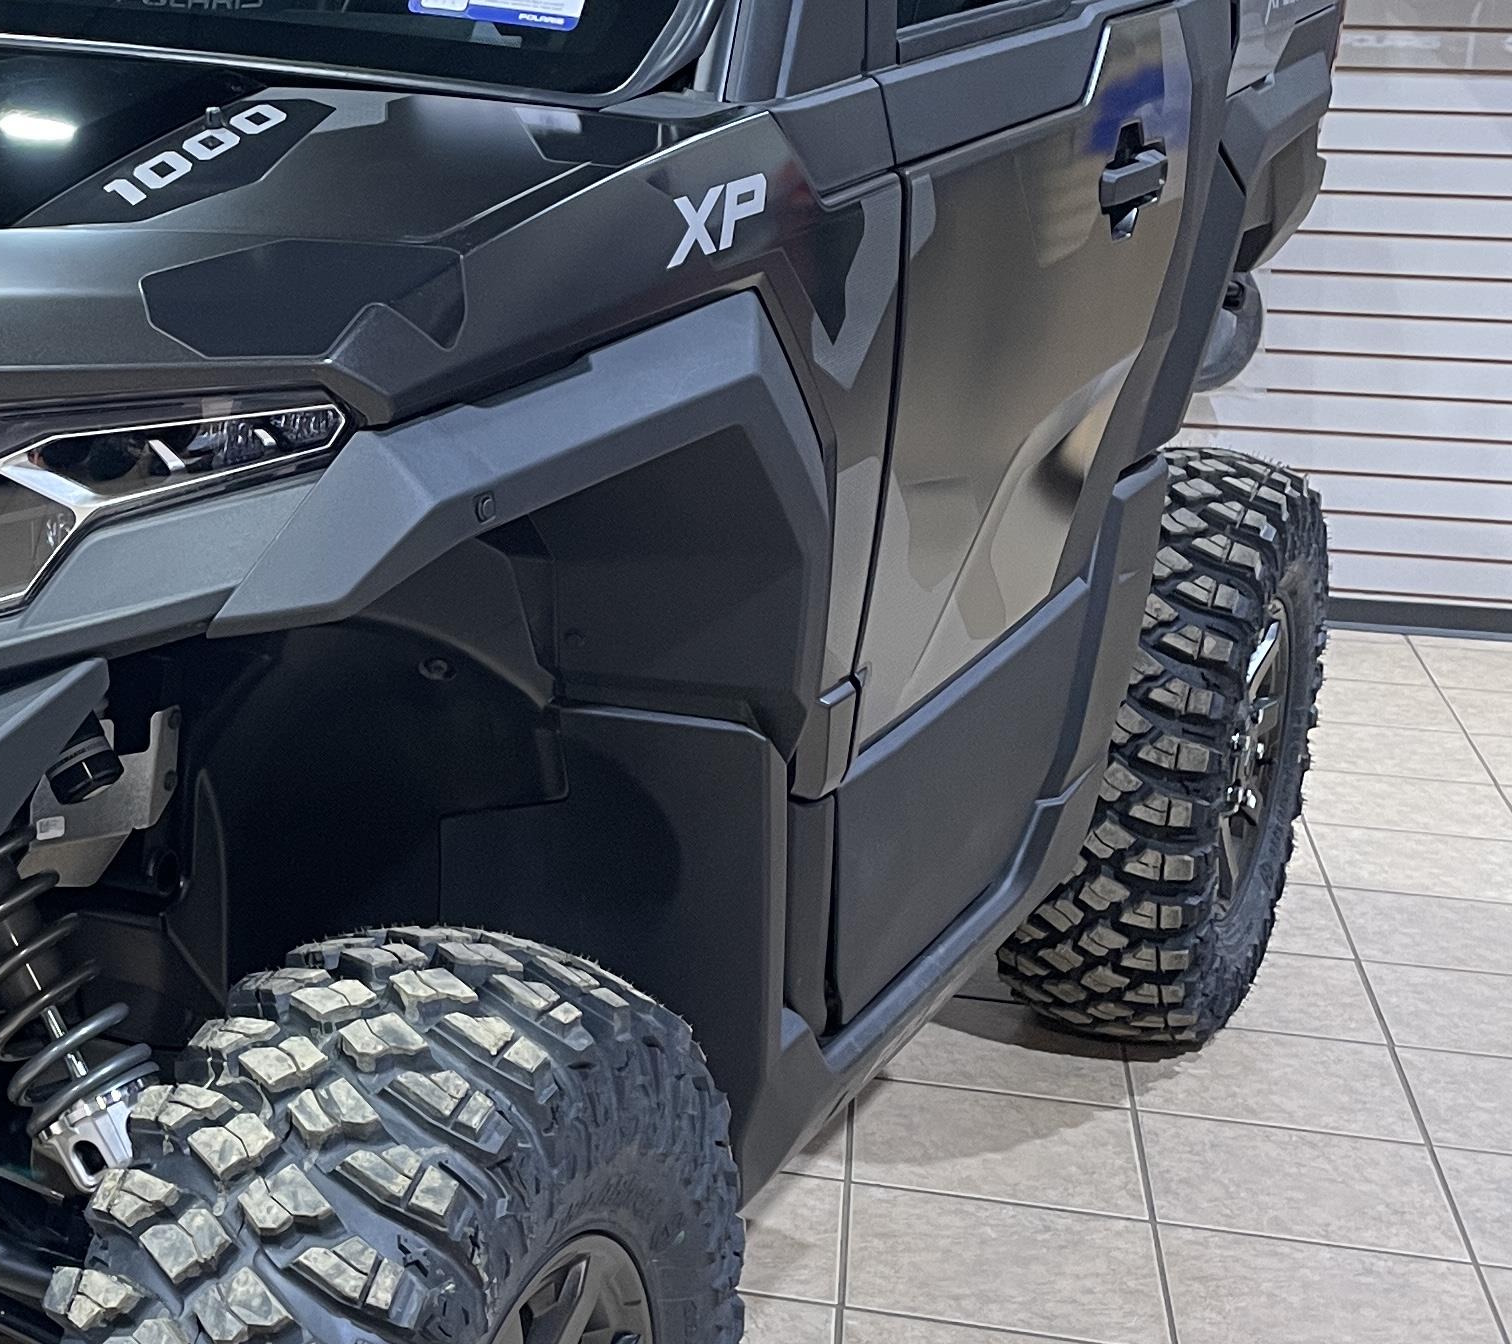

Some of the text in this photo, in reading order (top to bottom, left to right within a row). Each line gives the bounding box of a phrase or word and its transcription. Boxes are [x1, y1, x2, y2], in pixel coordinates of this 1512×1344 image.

[519, 13, 565, 25] POLARIS
[103, 104, 287, 206] 1000
[666, 173, 767, 269] XP
